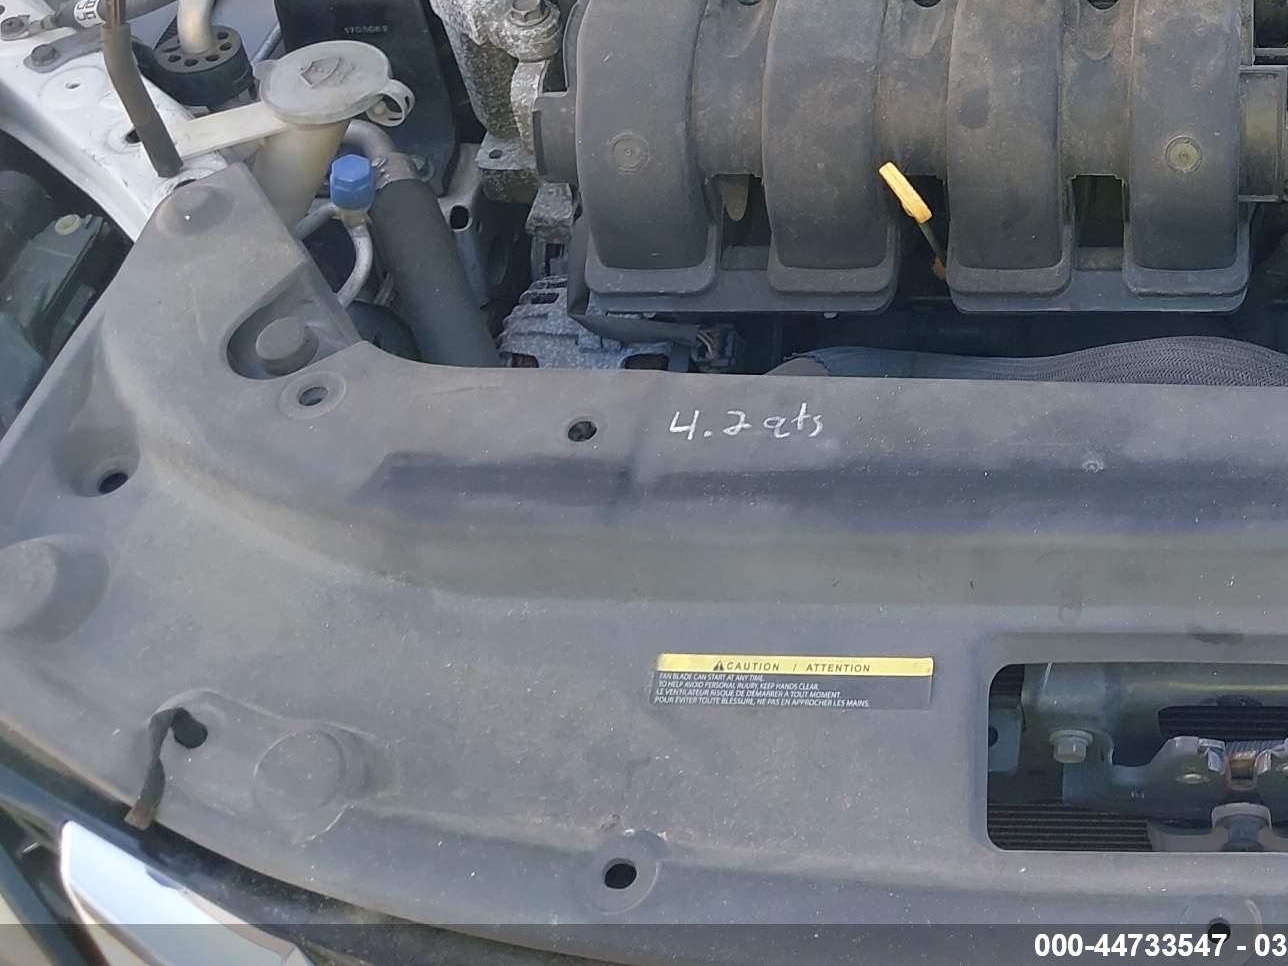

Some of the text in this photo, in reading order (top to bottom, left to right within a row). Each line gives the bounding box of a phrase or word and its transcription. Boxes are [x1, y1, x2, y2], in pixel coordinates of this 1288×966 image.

[669, 409, 753, 440] 4.2
[726, 661, 780, 672] CAUTION
[805, 662, 871, 673] ATTENTION
